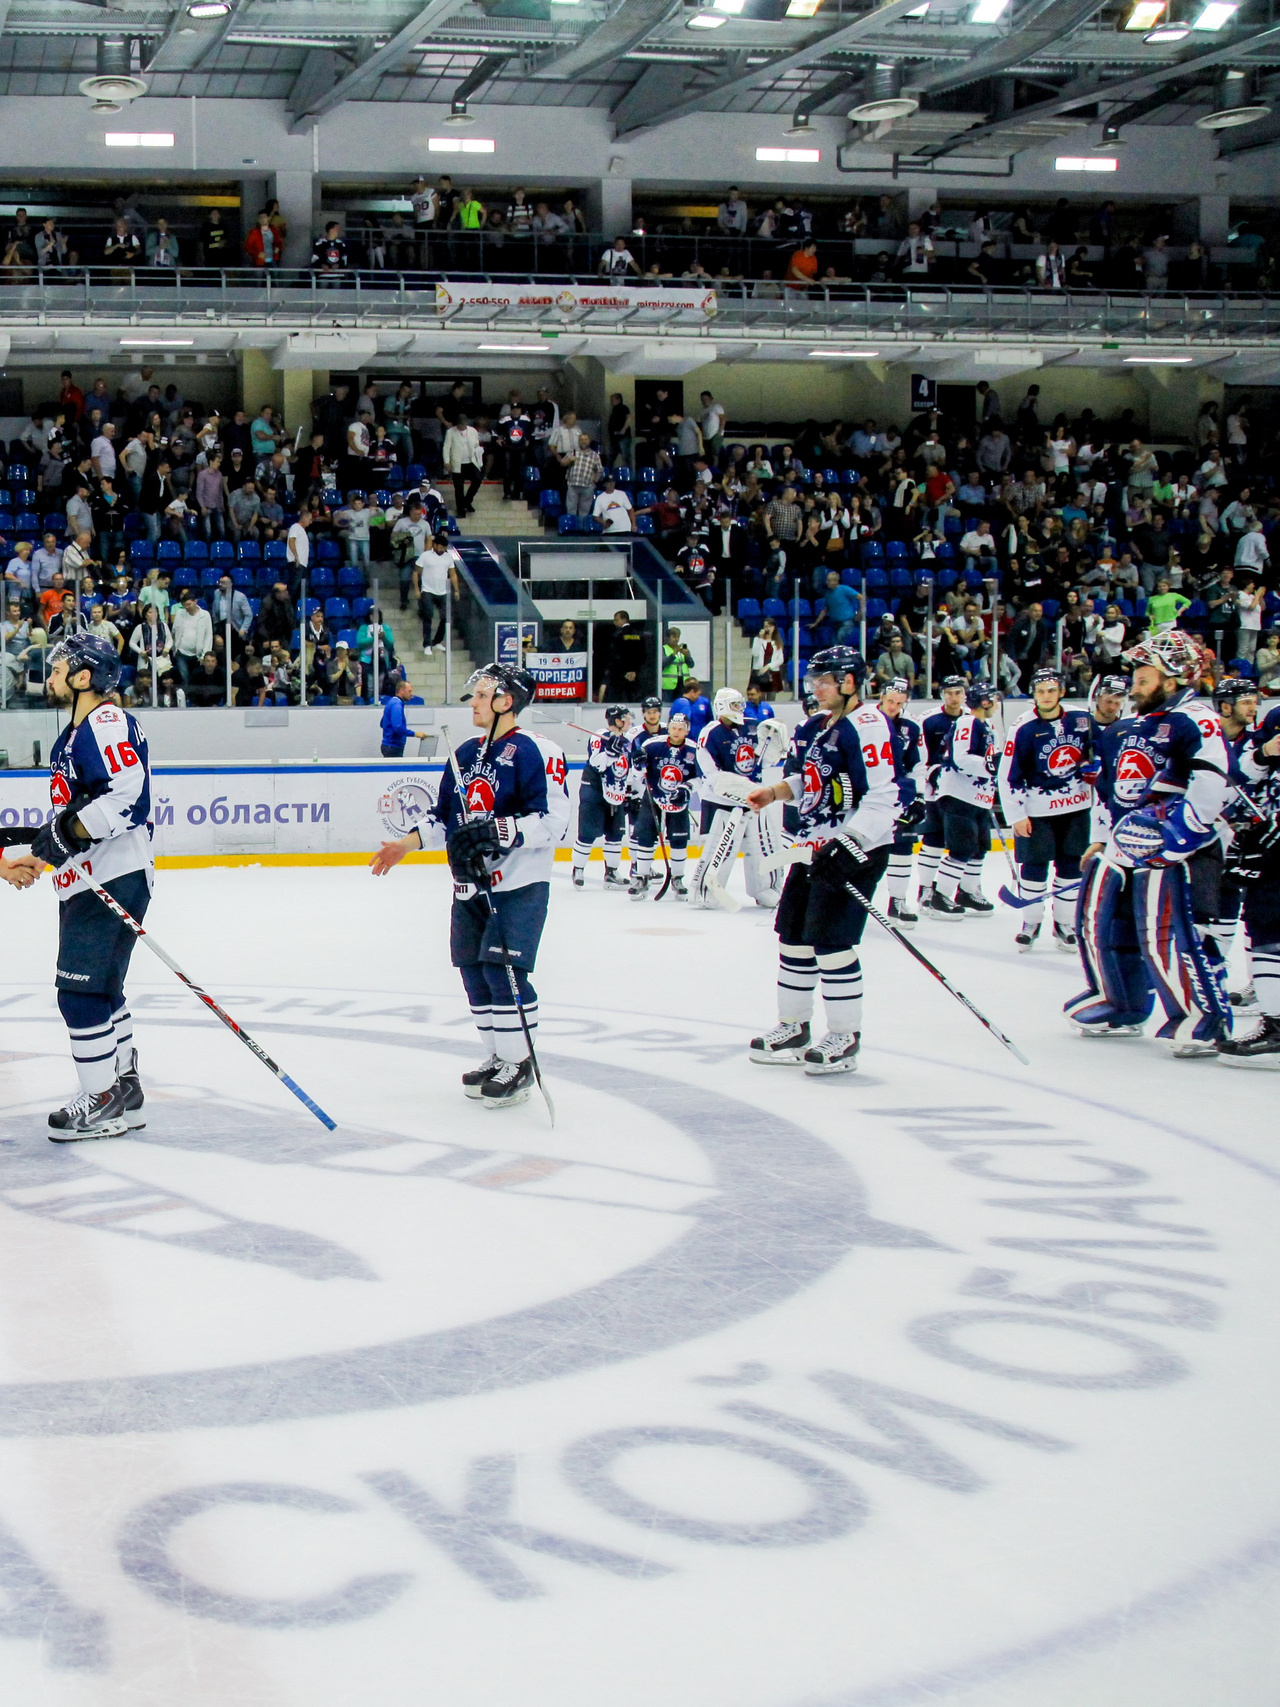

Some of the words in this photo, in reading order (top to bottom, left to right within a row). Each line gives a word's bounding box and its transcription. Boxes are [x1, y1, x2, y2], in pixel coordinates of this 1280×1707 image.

[919, 379, 929, 397] 4
[538, 657, 548, 666] 19
[531, 669, 583, 683] ТОРПЕДО
[538, 686, 576, 697] ВПЕРЕД!
[954, 727, 970, 742] 12
[104, 741, 139, 775] 16
[862, 741, 894, 768] 34
[545, 756, 567, 786] 45
[406, 776, 439, 800] ГУБЕРНАТОР
[186, 795, 331, 826] области
[712, 821, 736, 869] FRONTIER
[856, 1104, 1230, 1391] ОБЛАСТИ
